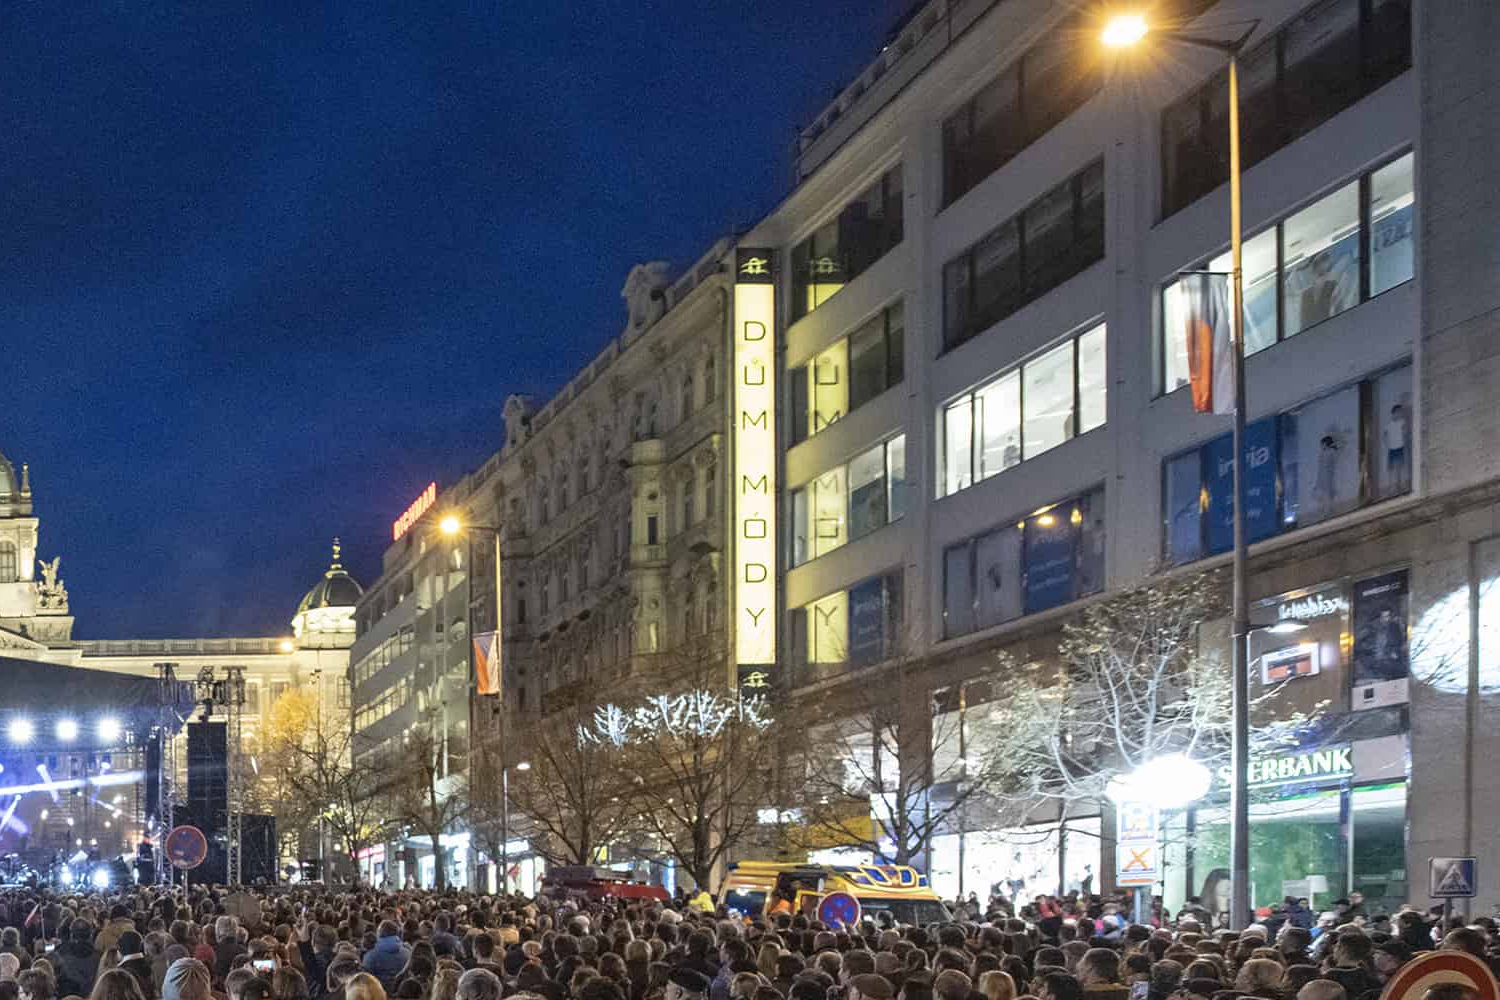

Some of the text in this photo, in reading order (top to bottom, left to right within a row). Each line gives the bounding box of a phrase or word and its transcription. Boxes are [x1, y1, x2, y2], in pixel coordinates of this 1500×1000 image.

[742, 320, 768, 627] DŮM MÓDY
[1218, 748, 1353, 786] SERBANK
